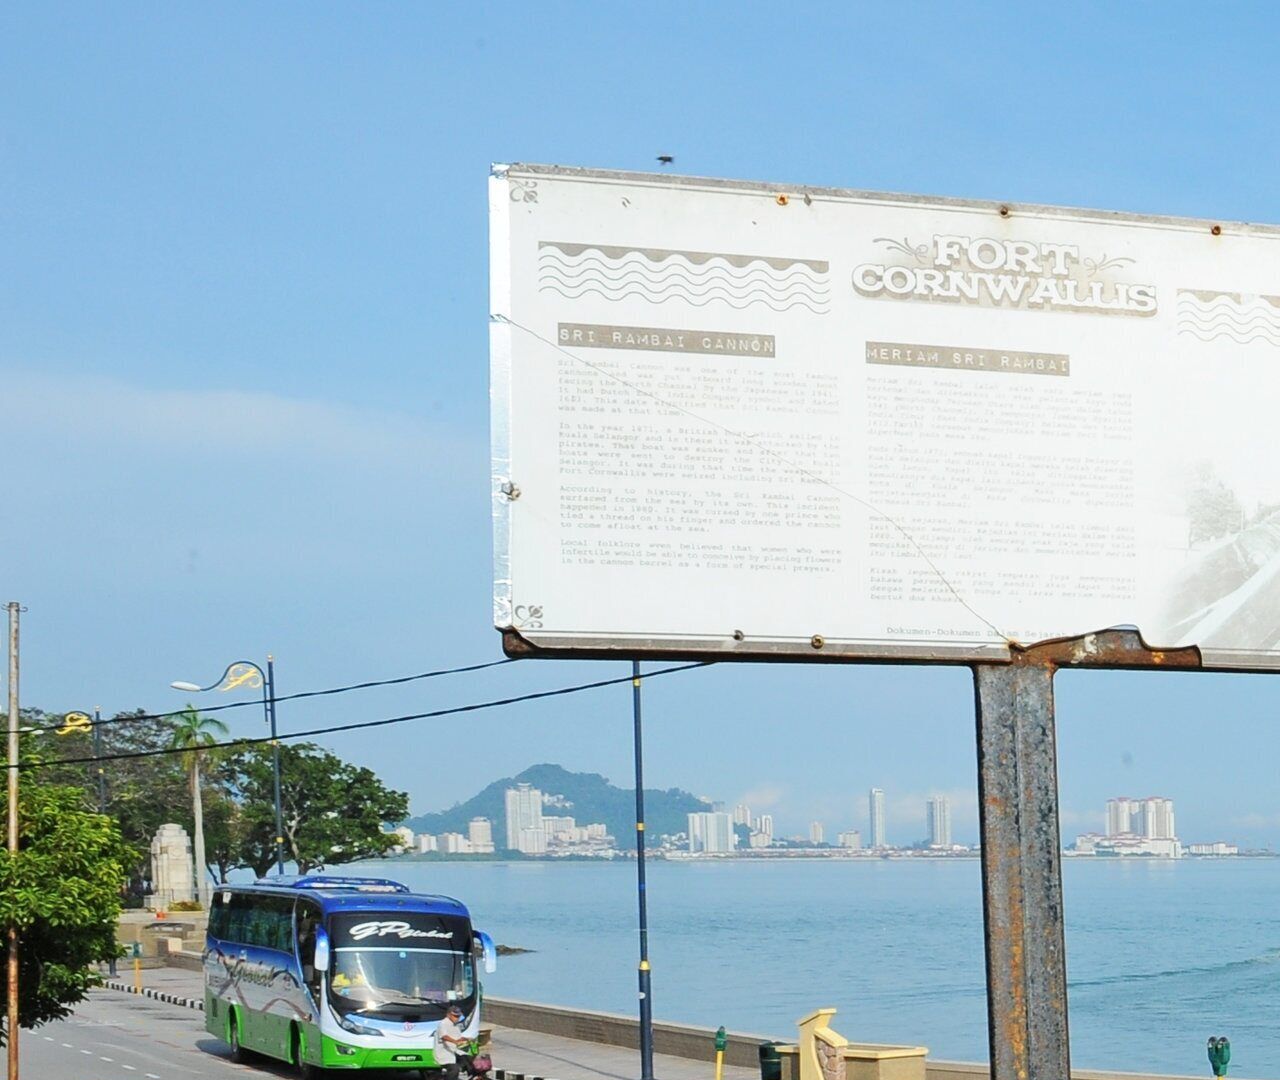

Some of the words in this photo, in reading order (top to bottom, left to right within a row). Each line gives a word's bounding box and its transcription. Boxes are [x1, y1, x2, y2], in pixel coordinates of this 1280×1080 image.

[933, 234, 1079, 275] FORT
[852, 263, 1158, 314] CORNWALLIS
[559, 328, 595, 343] SRI
[612, 331, 684, 348] RAMBAI
[866, 348, 939, 363] MERIAM
[952, 352, 985, 366] SRI
[1000, 356, 1068, 372] RAMBAI
